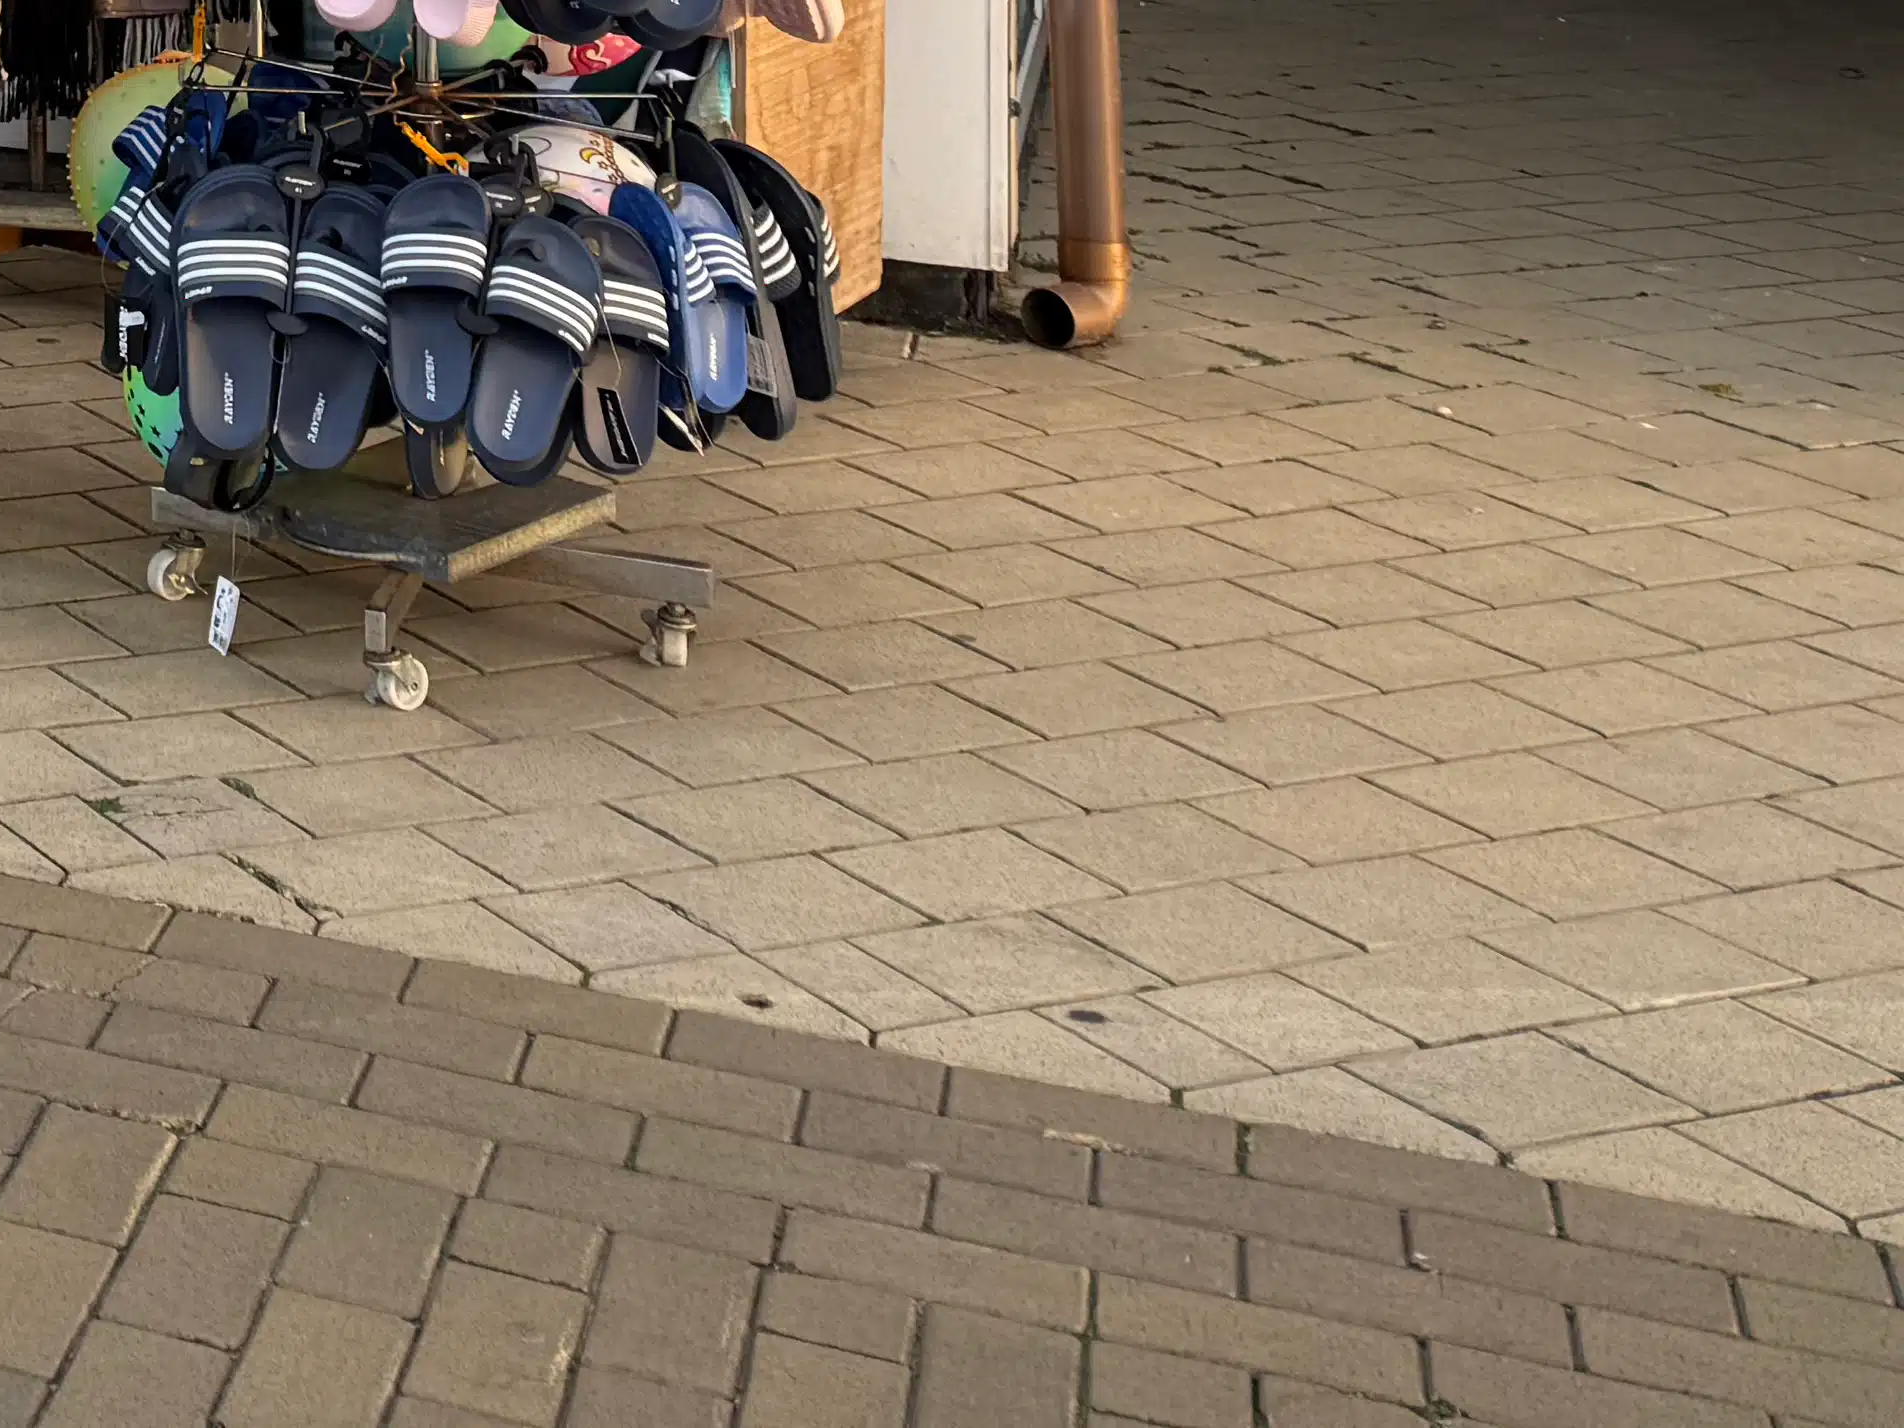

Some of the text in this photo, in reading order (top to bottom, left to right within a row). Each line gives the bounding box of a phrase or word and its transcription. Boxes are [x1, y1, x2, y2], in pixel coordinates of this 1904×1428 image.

[223, 373, 235, 425] RAYDEN
[425, 350, 437, 402] RAYDEN
[307, 393, 327, 444] RAYDEN
[501, 390, 523, 441] RAYDEN
